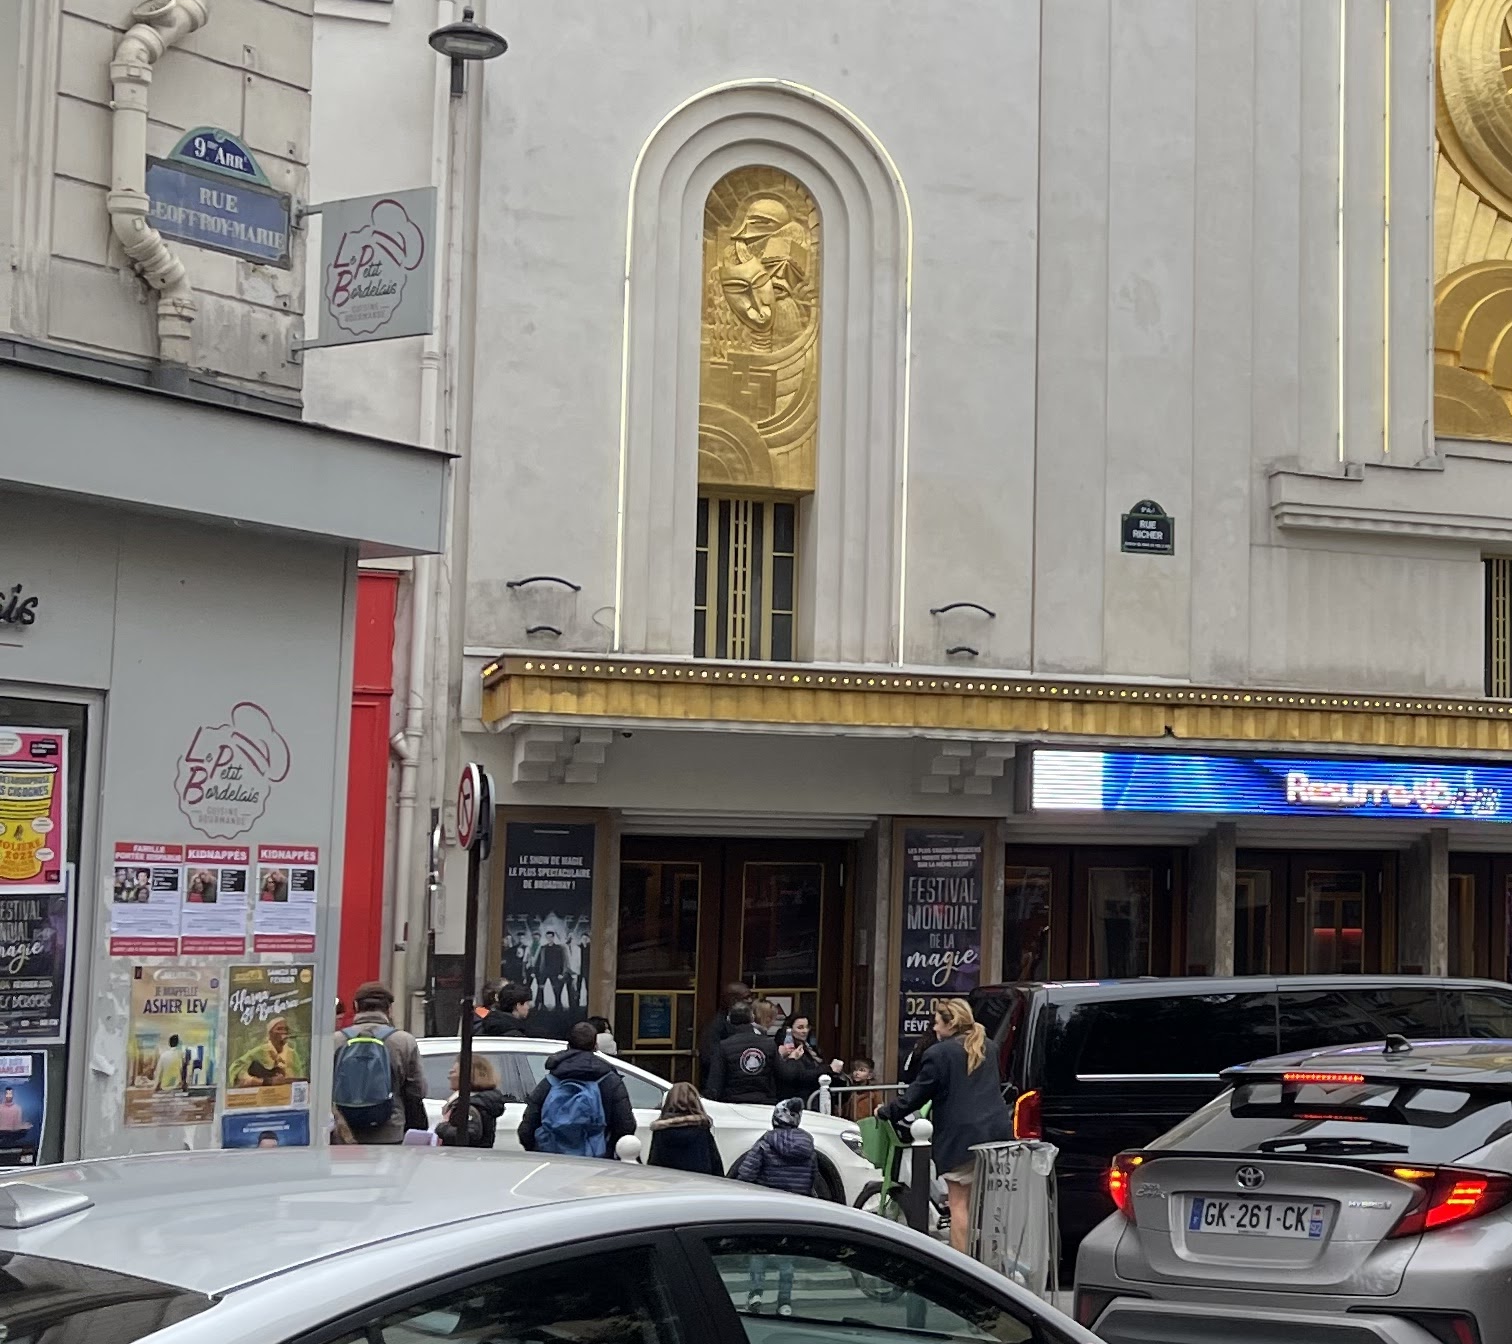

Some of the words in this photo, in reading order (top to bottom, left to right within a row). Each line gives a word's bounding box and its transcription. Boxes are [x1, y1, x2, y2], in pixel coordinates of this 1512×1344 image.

[200, 187, 239, 213] RUE
[354, 244, 383, 280] Petit
[332, 269, 397, 308] Bordelais
[1132, 529, 1163, 540] RICHER
[1139, 519, 1157, 530] RUE
[185, 726, 214, 764] Le
[210, 744, 243, 779] Petit
[183, 765, 260, 805] Bordelais
[187, 848, 247, 861] KIDNAPPÉS
[260, 848, 317, 861] KIDNAPPÉS
[909, 876, 978, 904] FESTIVAL
[0, 899, 42, 921] ESTIVAL
[907, 904, 977, 931] MONDIAL
[930, 933, 941, 949] DE
[943, 933, 955, 949] LA
[907, 948, 979, 987] magie
[143, 998, 183, 1014] ASHER
[187, 998, 209, 1014] LEV
[1204, 1201, 1309, 1232] GK-261-CK
